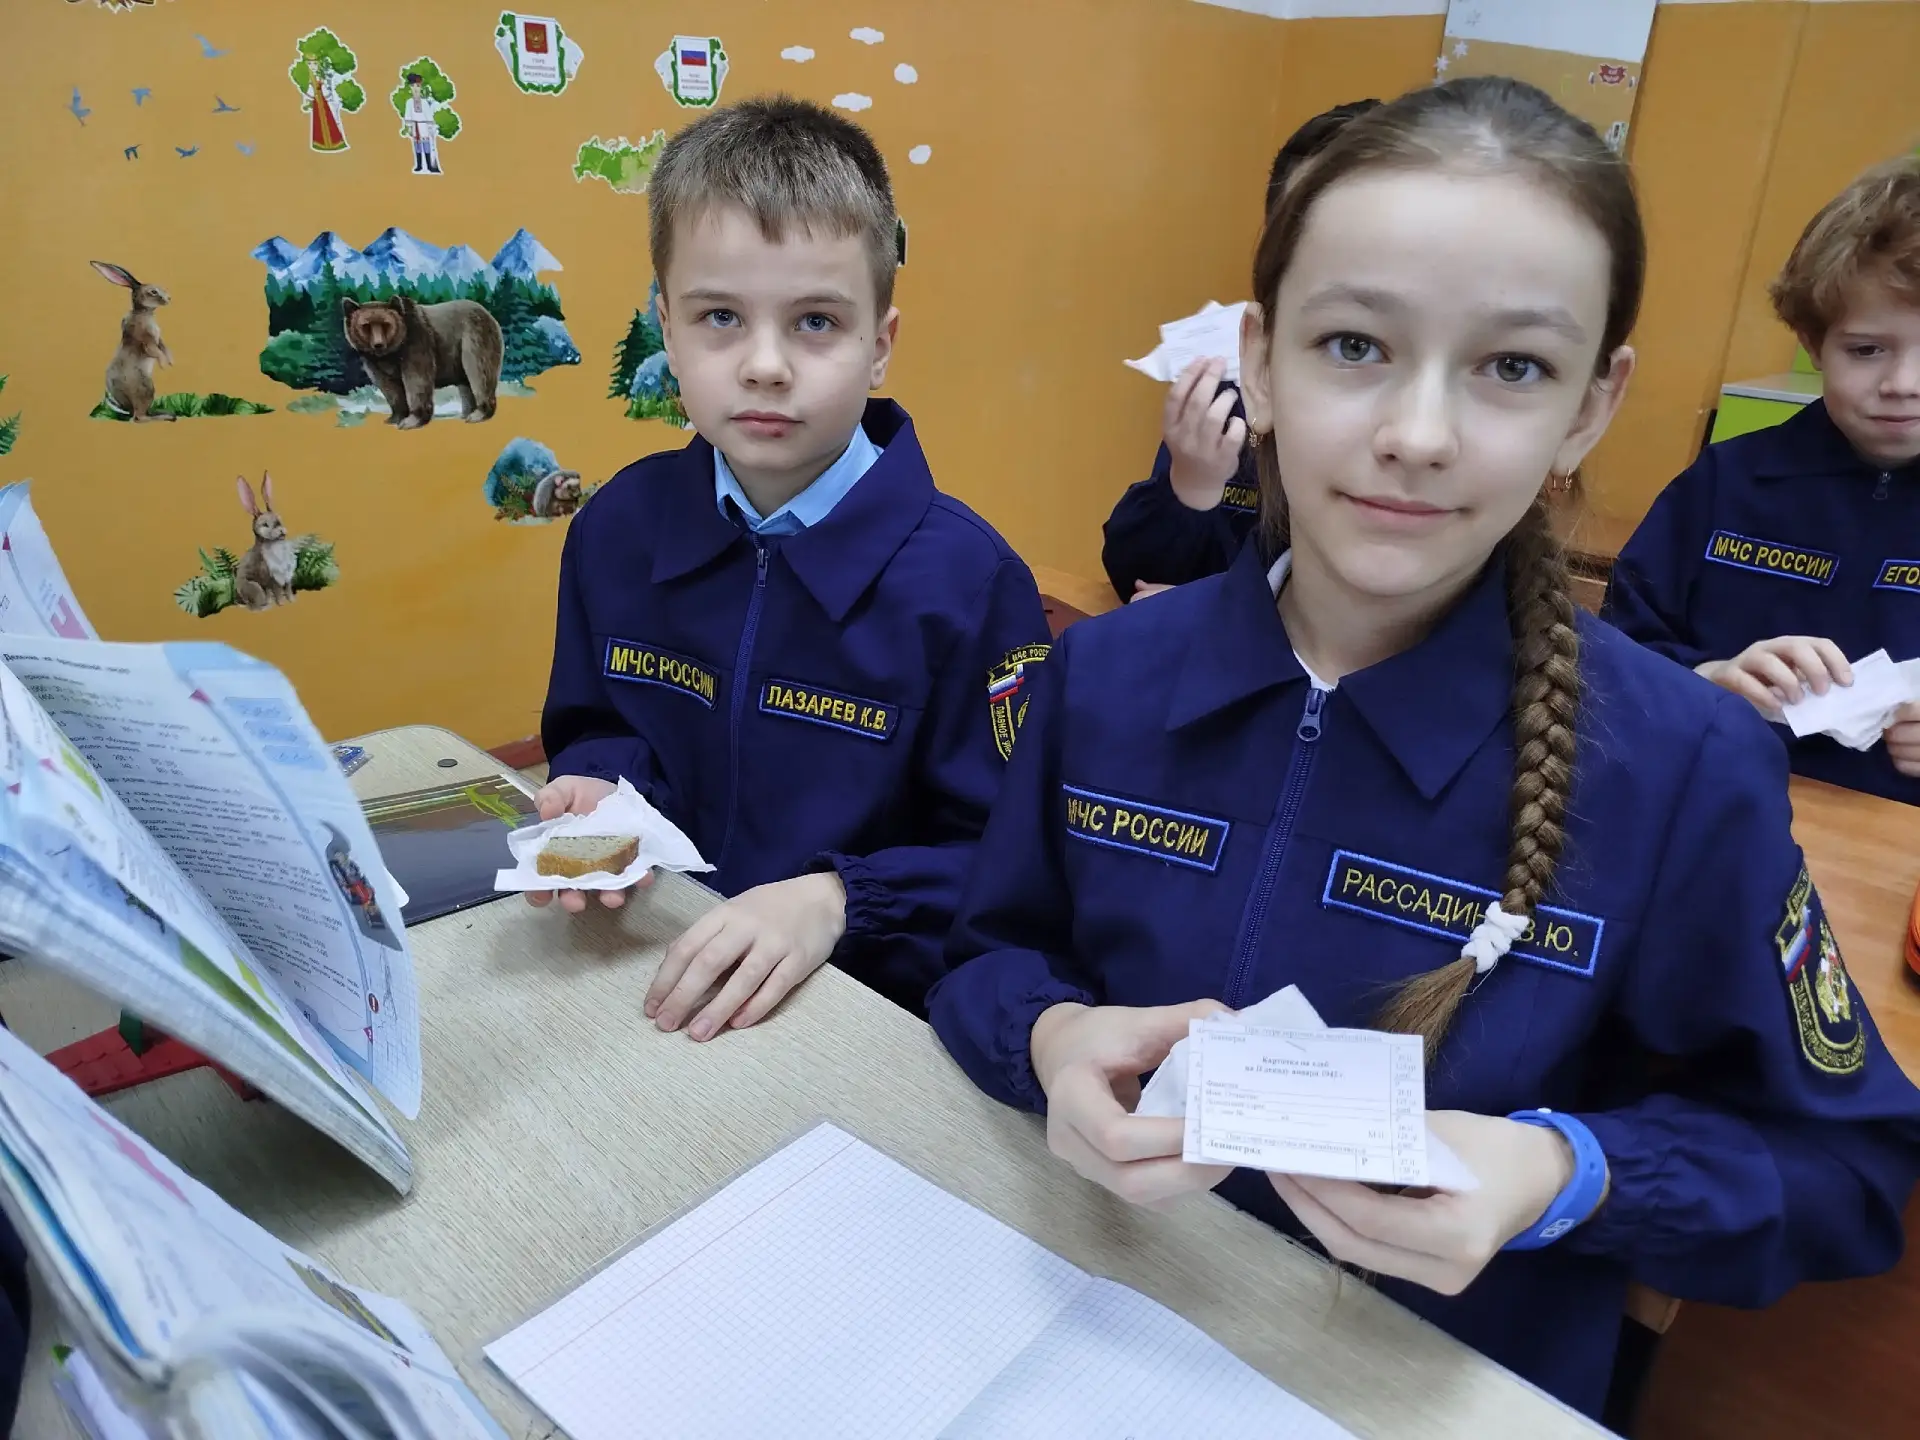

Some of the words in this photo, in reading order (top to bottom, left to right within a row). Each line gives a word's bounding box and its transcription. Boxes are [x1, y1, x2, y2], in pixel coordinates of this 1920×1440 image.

[1714, 536, 1753, 562] МЧС
[1755, 546, 1833, 579] РОССИИ
[1883, 566, 1920, 586] ЕГО
[610, 646, 655, 676] МЧС
[659, 656, 714, 701] РОССИИ
[767, 685, 855, 722] ЛАЗАРЕВ
[860, 706, 887, 731] К.В.
[1067, 797, 1107, 832] МЧС
[1111, 808, 1209, 857] РОССИИ
